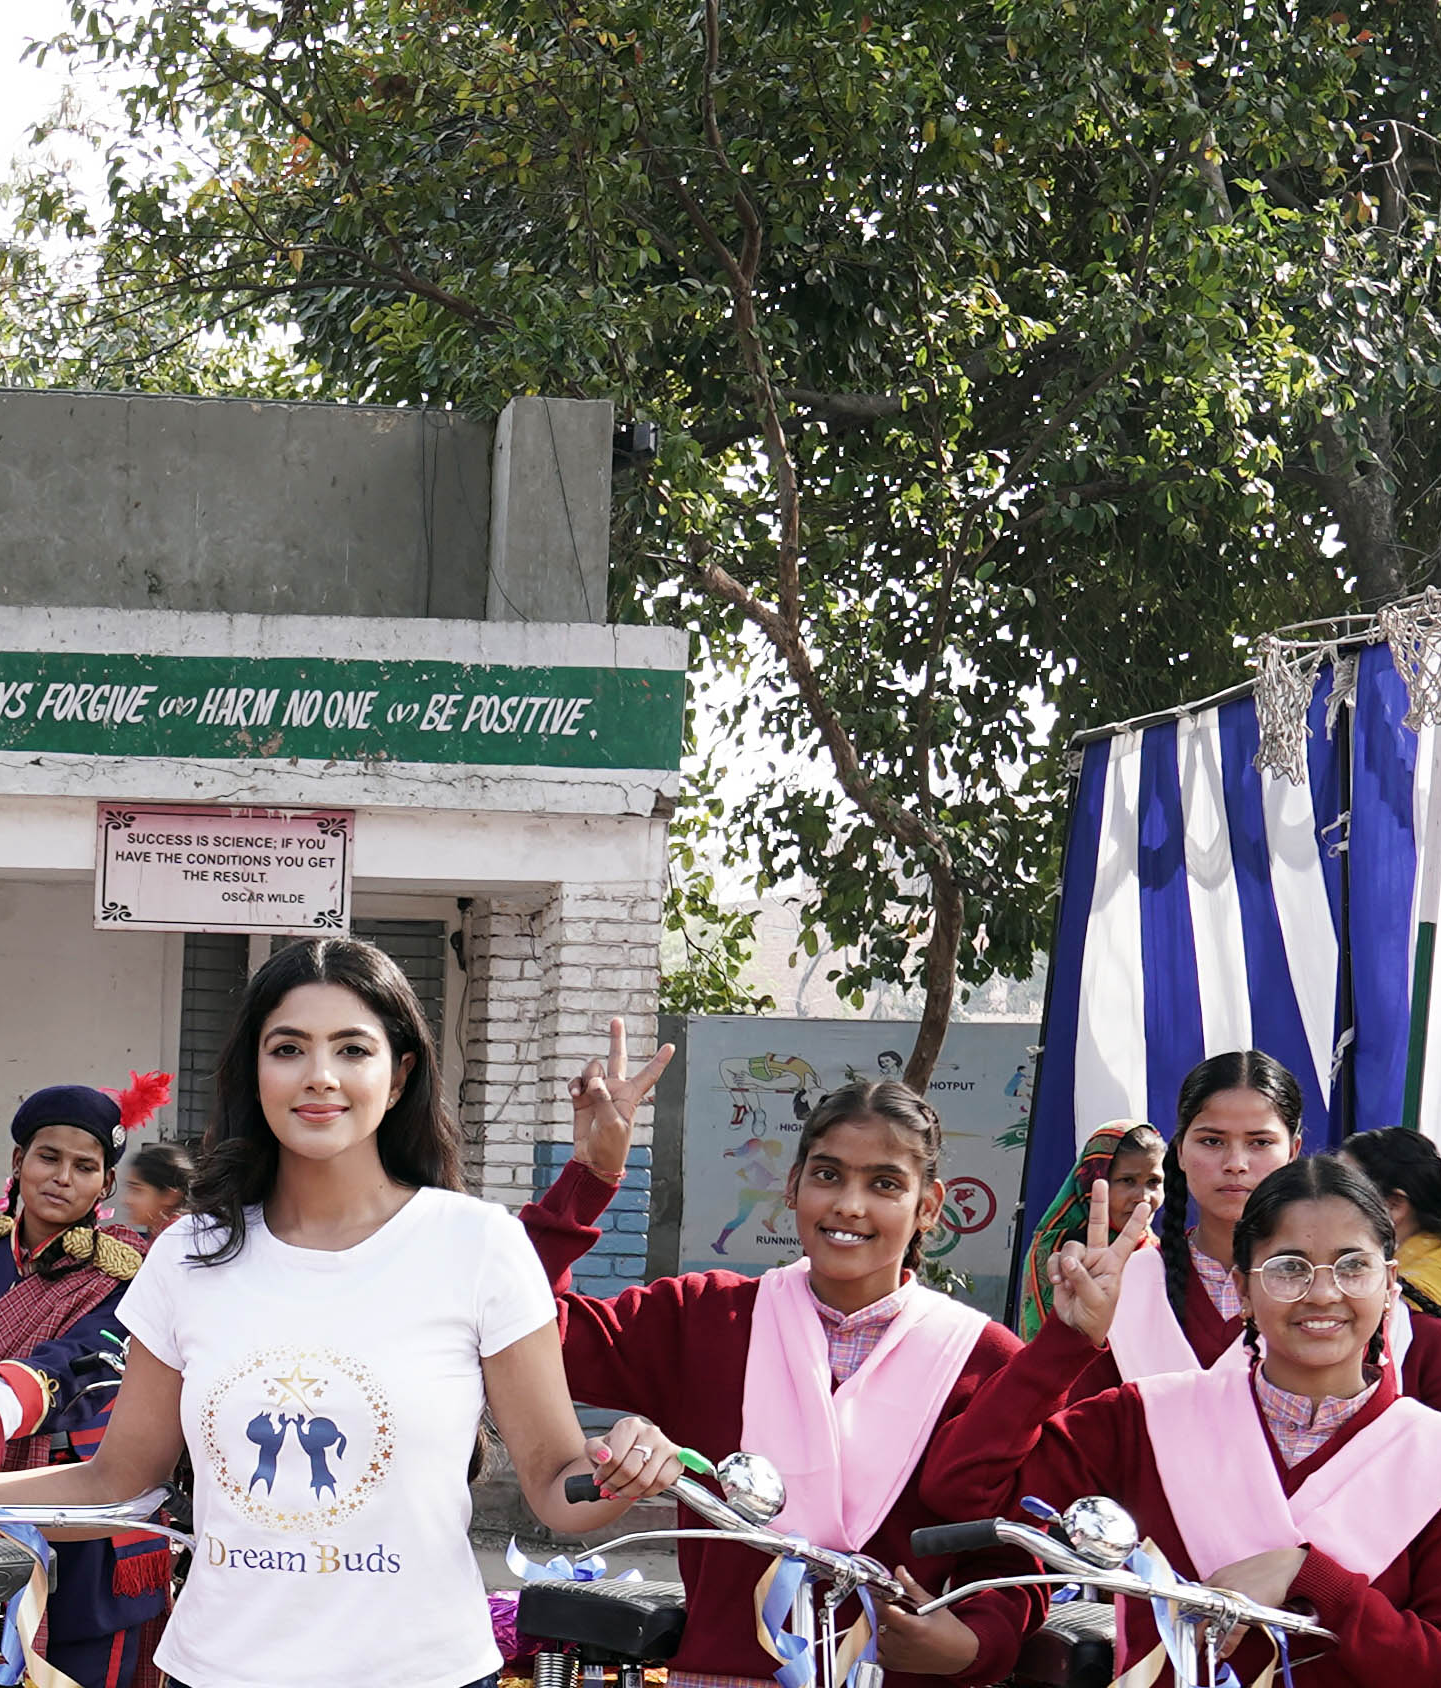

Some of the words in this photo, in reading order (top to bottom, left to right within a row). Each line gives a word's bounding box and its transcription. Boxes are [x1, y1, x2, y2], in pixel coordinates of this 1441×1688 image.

[36, 683, 158, 725] FORGIVE
[197, 687, 276, 727] HARM
[283, 690, 325, 729] NO
[324, 690, 379, 730] ONE
[420, 693, 459, 731] BE
[127, 833, 192, 846] SUCCESS
[196, 836, 208, 847] IS
[213, 836, 277, 850] SCIENCE;
[282, 838, 293, 848] IF
[297, 838, 326, 850] YOU
[115, 851, 151, 863] HAVE
[156, 852, 182, 864] THE
[186, 853, 271, 867] CONDITIONS
[275, 856, 304, 868] YOU
[308, 857, 335, 869] GET
[183, 870, 209, 882] THE
[213, 871, 268, 884] RESULT.
[221, 892, 264, 903] OSCAR
[267, 893, 305, 904] WILDE
[206, 1534, 307, 1573] Dream
[315, 1541, 401, 1574] Buds
